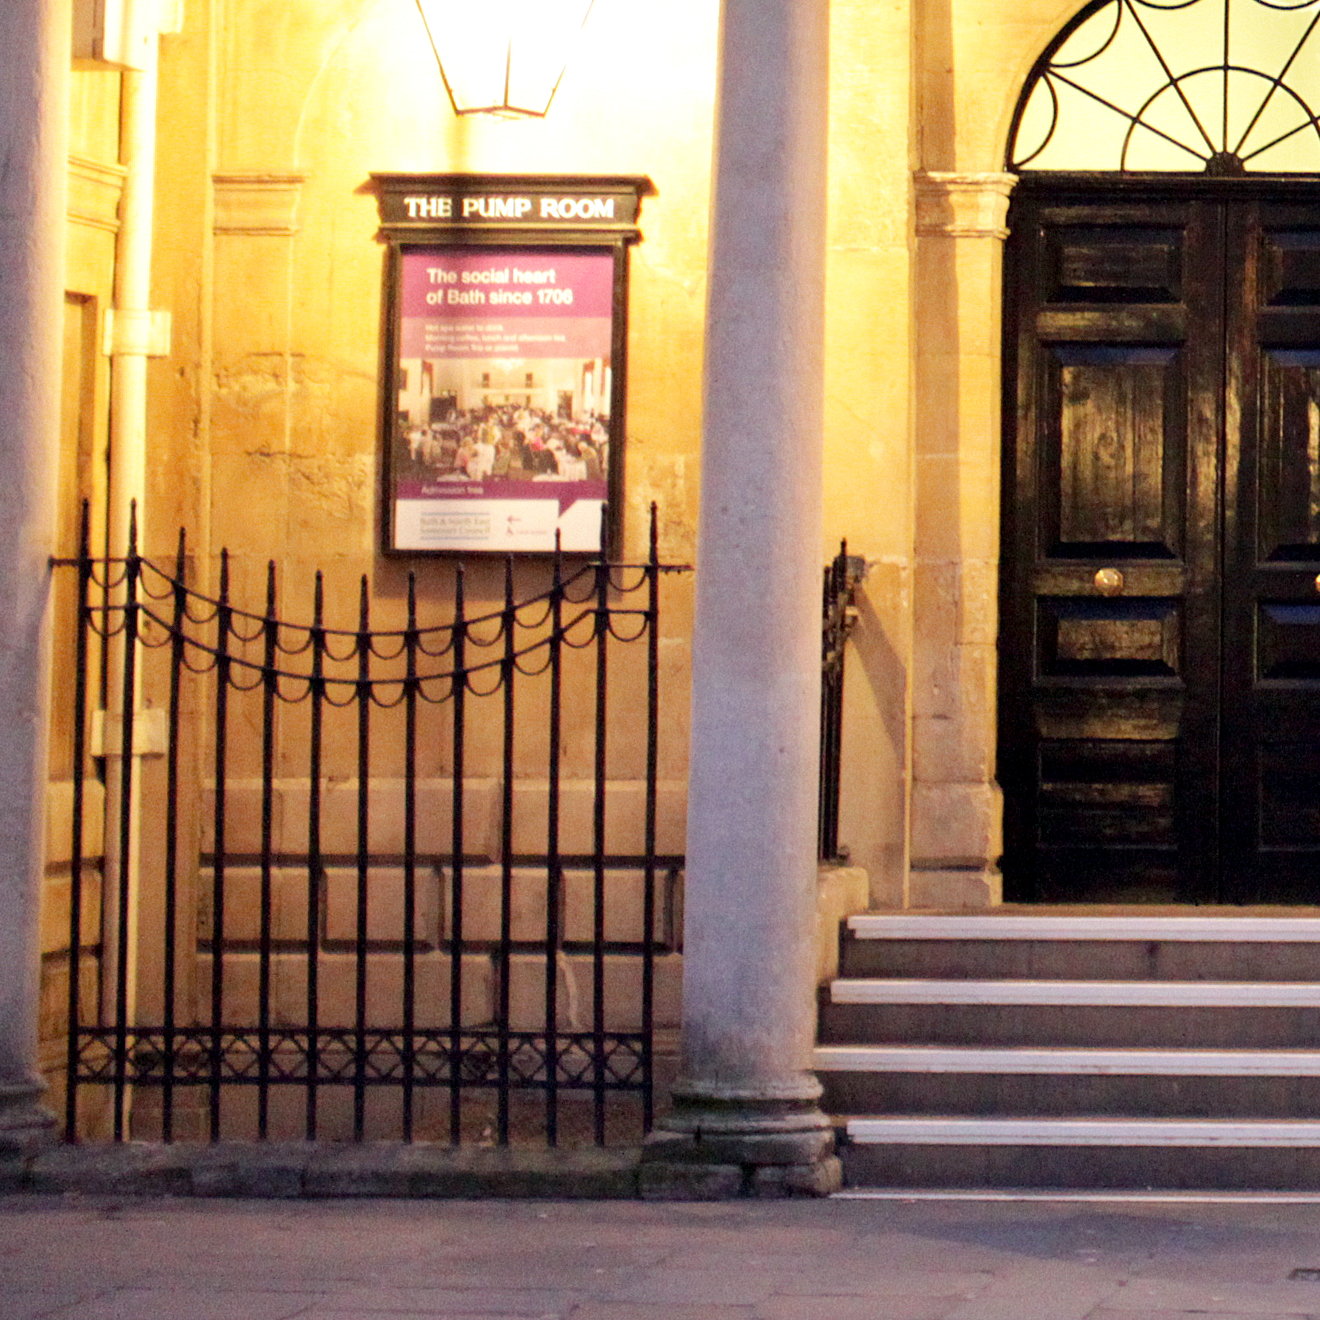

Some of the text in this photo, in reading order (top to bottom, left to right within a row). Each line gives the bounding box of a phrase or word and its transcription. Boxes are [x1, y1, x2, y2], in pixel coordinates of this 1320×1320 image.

[403, 197, 615, 219] THE PUMP ROOM
[427, 267, 556, 285] The social heart
[426, 288, 574, 305] of Bath since 1706
